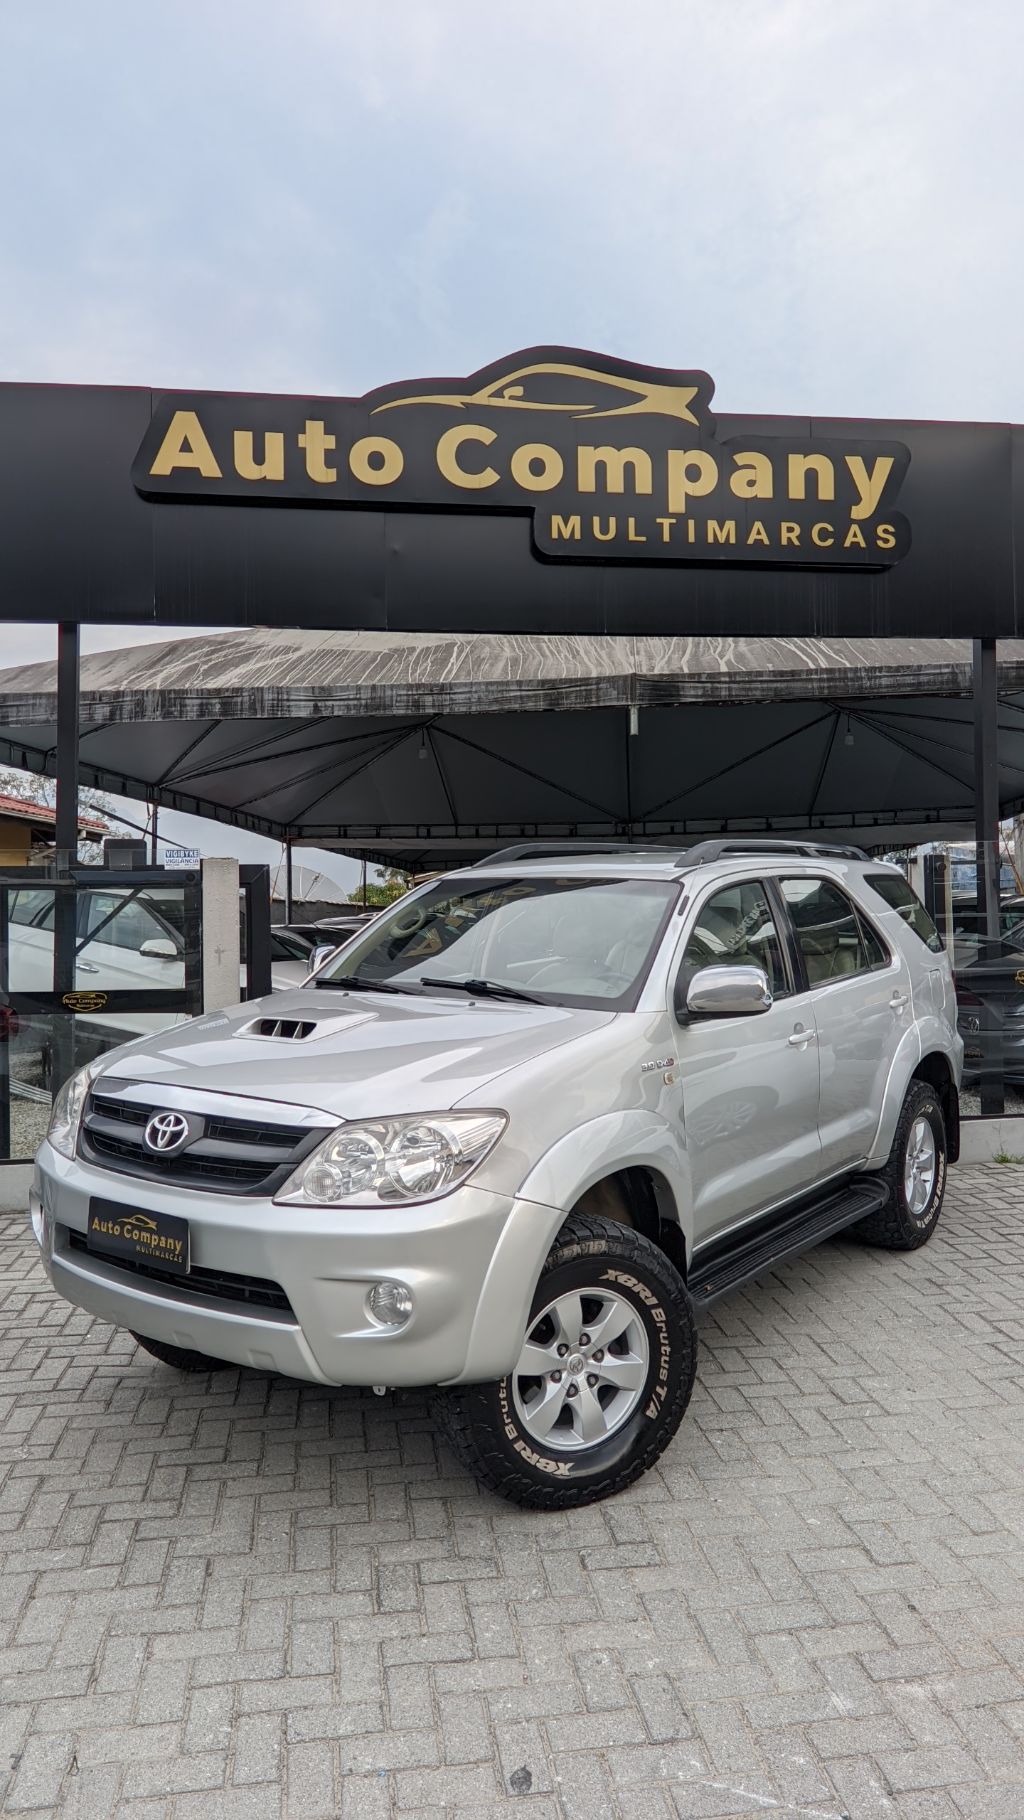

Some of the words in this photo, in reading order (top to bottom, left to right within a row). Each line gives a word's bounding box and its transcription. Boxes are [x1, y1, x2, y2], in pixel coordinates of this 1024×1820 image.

[149, 411, 404, 486] Auto
[436, 424, 894, 521] Company
[551, 514, 897, 549] MULTIMARCAS
[92, 1216, 120, 1235] Auto
[123, 1225, 183, 1254] Company
[136, 1244, 183, 1263] MULTIMARCAS
[598, 1268, 659, 1306] XBRI
[651, 1307, 671, 1382] Brutus
[645, 1385, 668, 1420] T/A
